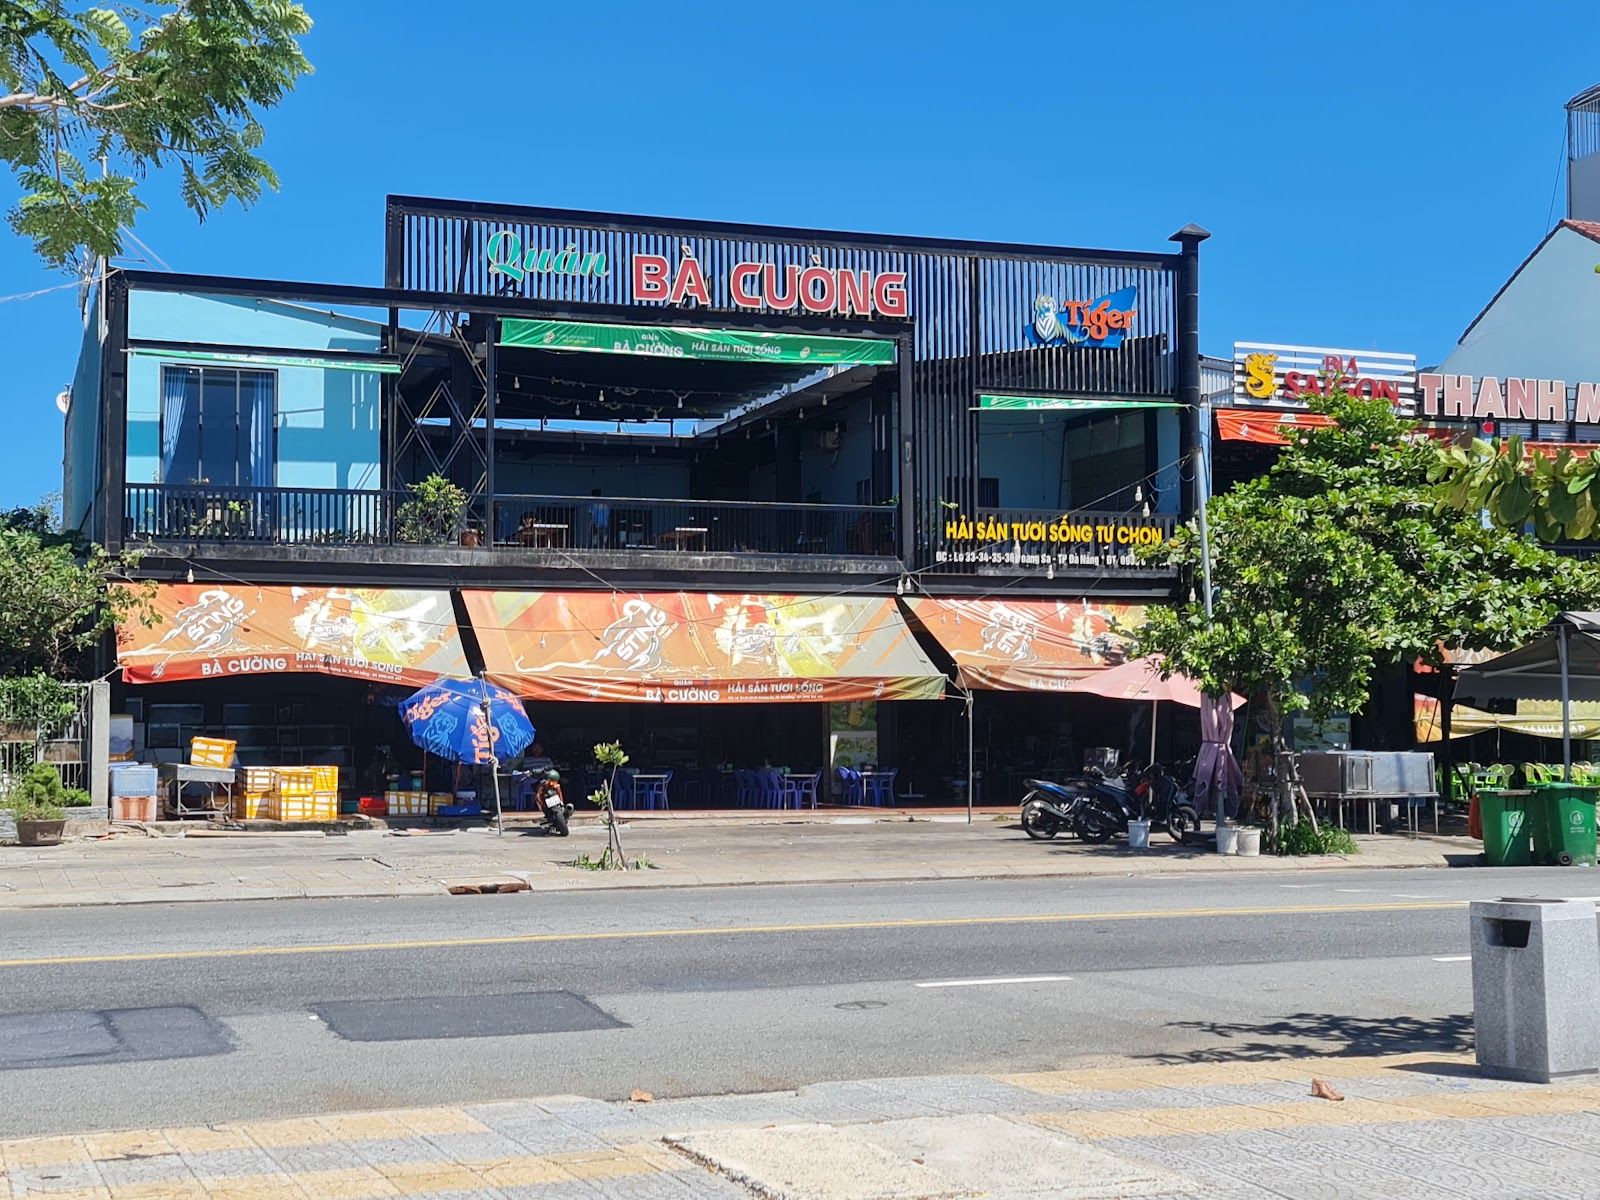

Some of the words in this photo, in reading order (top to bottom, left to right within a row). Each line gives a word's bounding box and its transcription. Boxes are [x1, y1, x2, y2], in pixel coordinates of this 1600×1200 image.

[487, 230, 610, 284] Quán
[632, 245, 711, 305] BÀ
[730, 254, 908, 317] CƯỜNG
[1064, 298, 1137, 339] Tiger
[1419, 373, 1567, 421] THANH
[945, 515, 973, 539] HẢI
[976, 516, 1008, 540] SẢN
[1011, 521, 1046, 541] TƯƠI
[1049, 514, 1093, 542] SỐNG
[187, 598, 245, 641] STING
[617, 608, 667, 660] STING
[202, 659, 224, 676] BÀ
[227, 656, 288, 672] CƯỜNG
[668, 687, 720, 701] CƯỜNG
